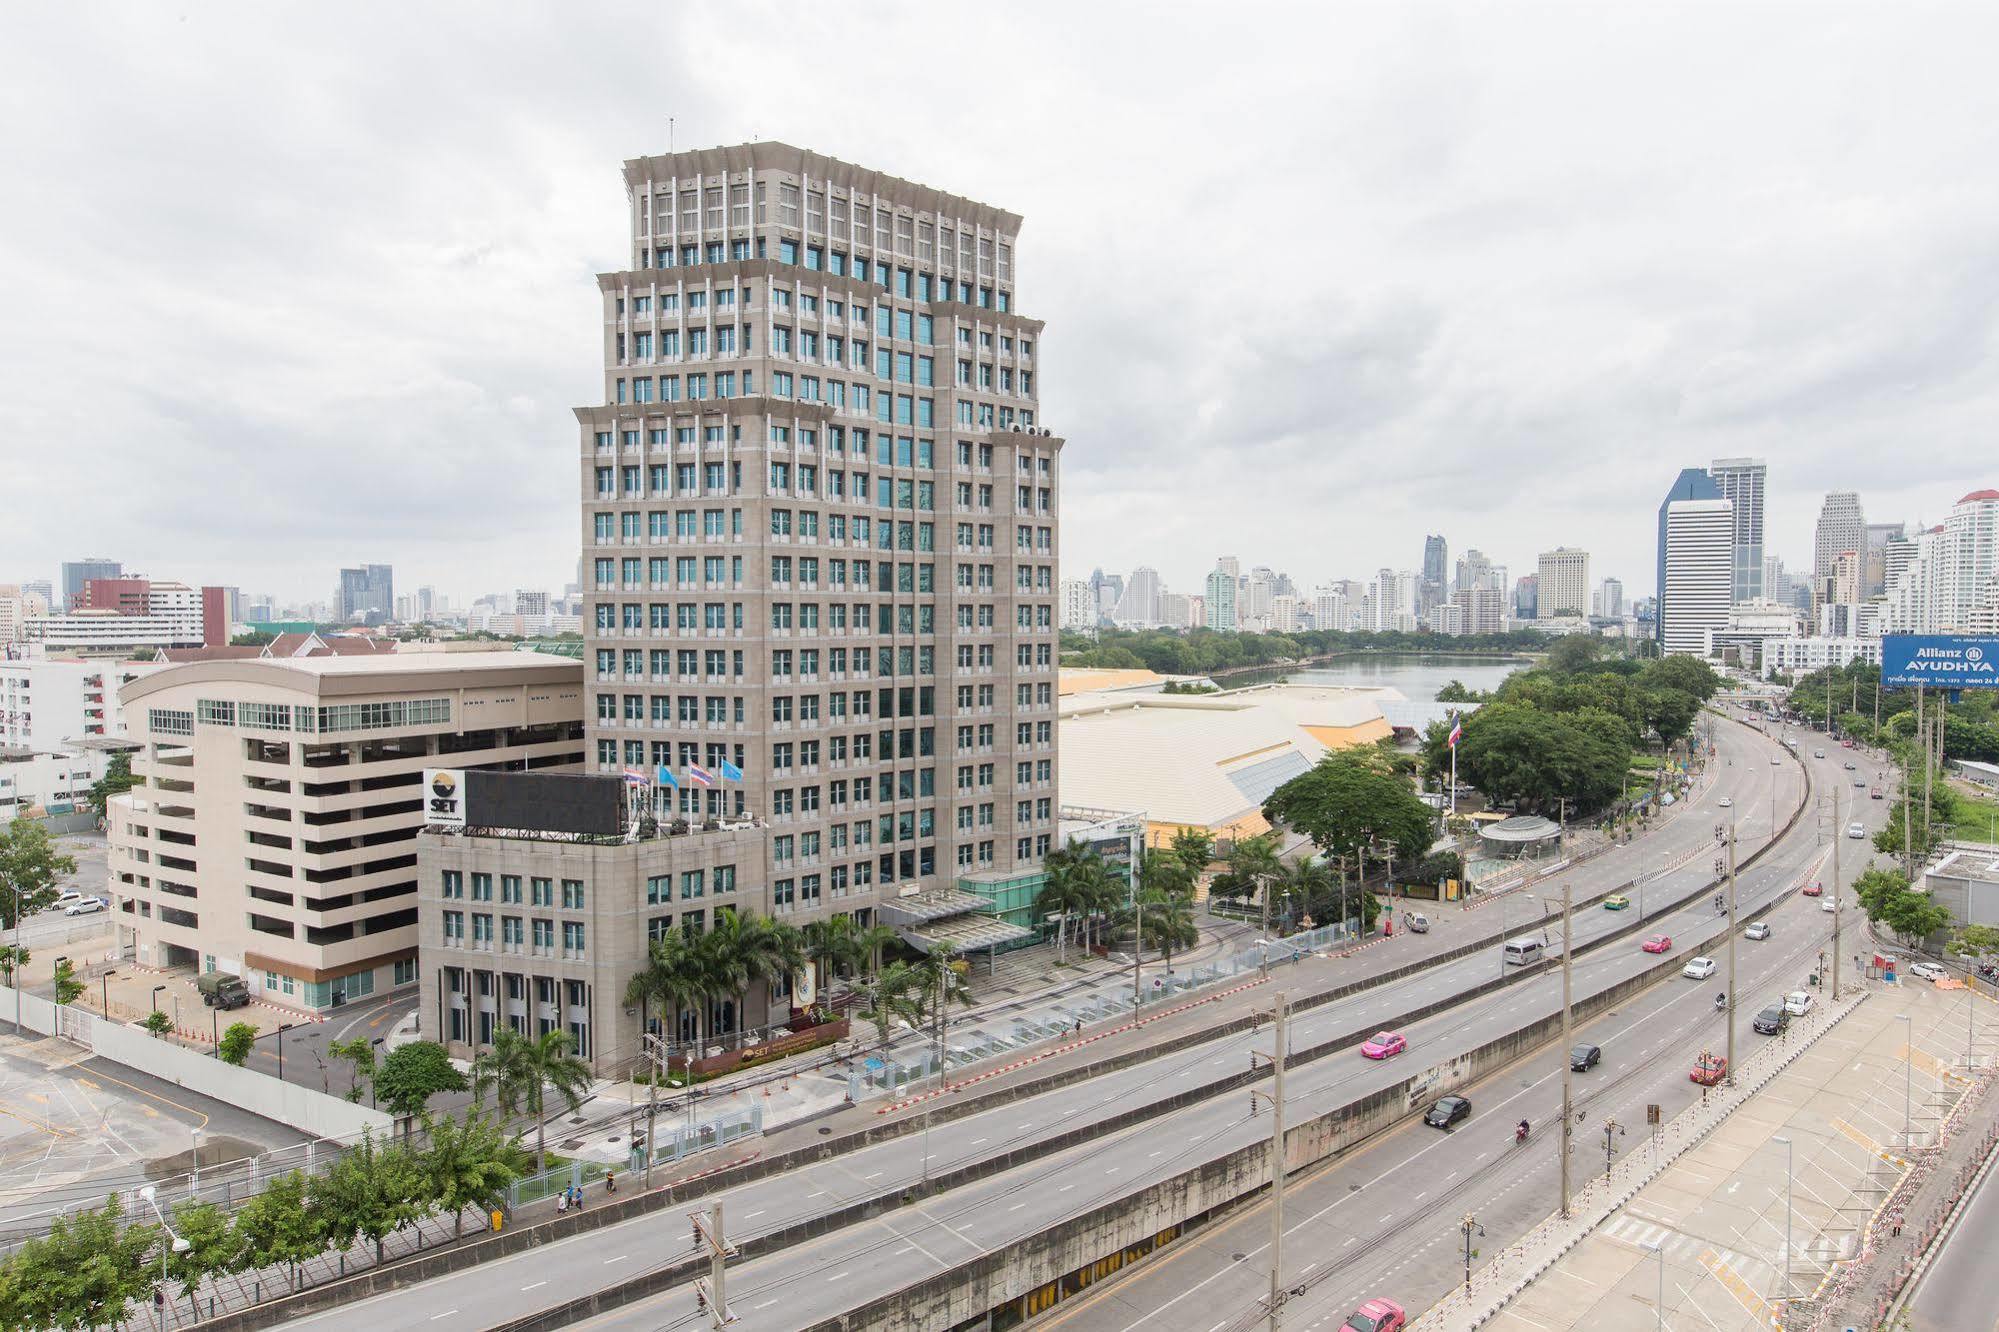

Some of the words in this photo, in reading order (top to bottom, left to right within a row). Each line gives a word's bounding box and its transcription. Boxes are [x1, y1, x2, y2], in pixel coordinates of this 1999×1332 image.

[1916, 648, 1961, 658] Allianz
[1905, 661, 1994, 672] AYUDHYA
[430, 799, 458, 813] SET
[754, 1047, 769, 1057] SET
